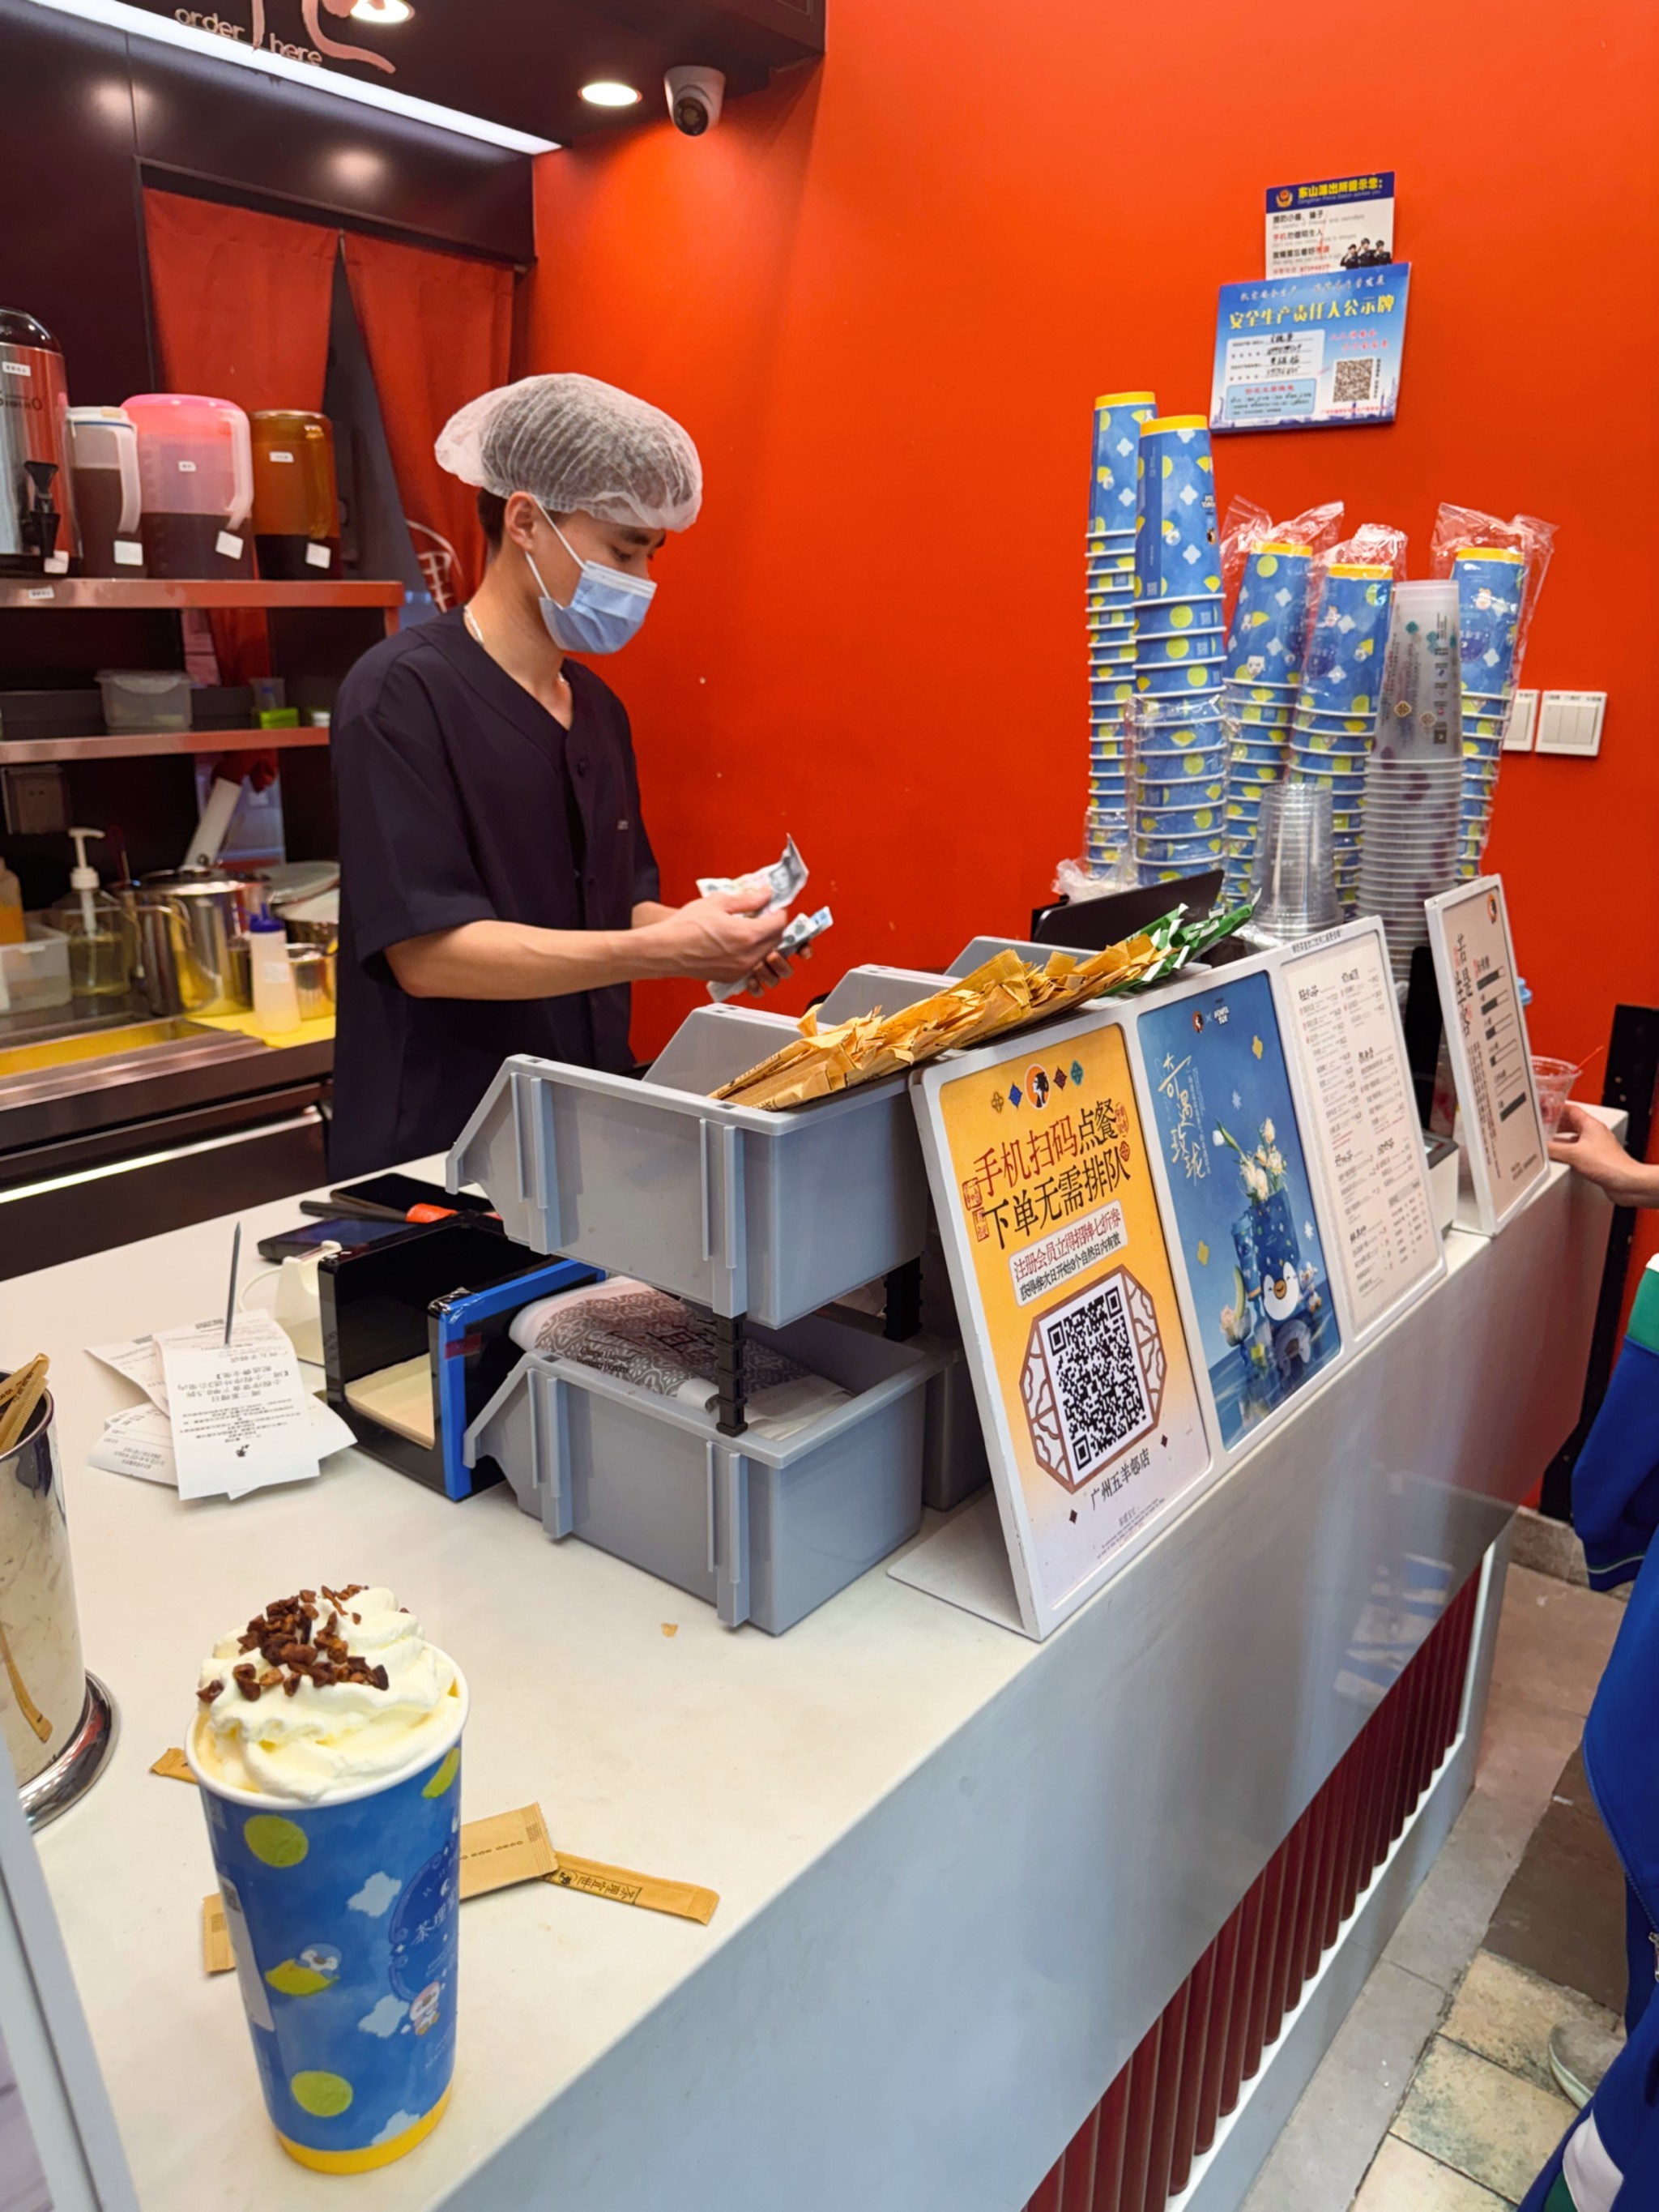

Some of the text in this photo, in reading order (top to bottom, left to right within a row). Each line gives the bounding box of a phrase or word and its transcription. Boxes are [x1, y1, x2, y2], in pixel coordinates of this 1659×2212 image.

[175, 8, 245, 40] order
[270, 33, 323, 67] here
[1229, 295, 1395, 330] 安全生产责任人公示牌
[972, 1098, 1119, 1198] 手机扫码点餐
[983, 1147, 1131, 1250] 下单无需排队
[1013, 1210, 1122, 1283] 注册会员立得招牌七折券
[1090, 1448, 1150, 1510] 广州五羊邨店
[578, 1876, 635, 1901] 茶理宜世
